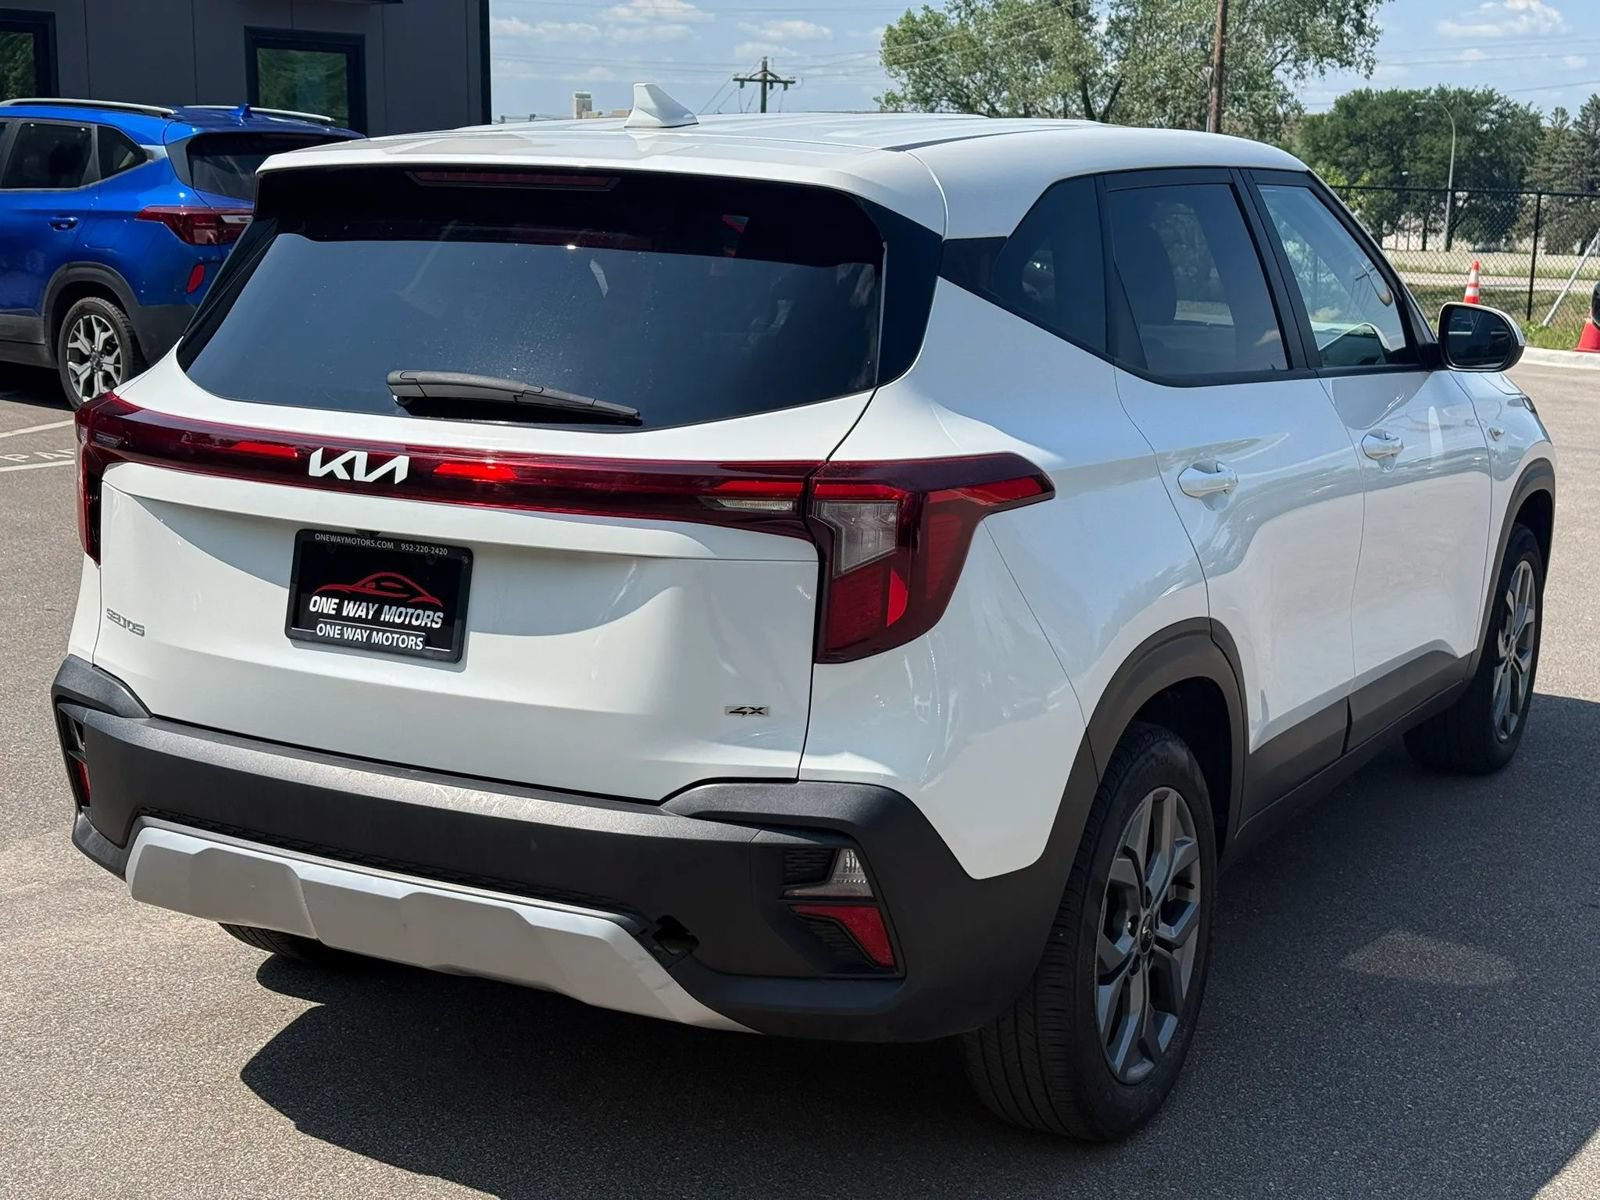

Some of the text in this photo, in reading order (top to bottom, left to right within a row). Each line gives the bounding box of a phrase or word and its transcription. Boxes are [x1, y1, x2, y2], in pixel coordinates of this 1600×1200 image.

[308, 447, 409, 484] KIA
[314, 532, 448, 556] ONEWAYMOTORS.COM 952-220-2420
[309, 595, 444, 629] ONE WAY MOTORS
[316, 623, 424, 651] ONE WAY MOTORS
